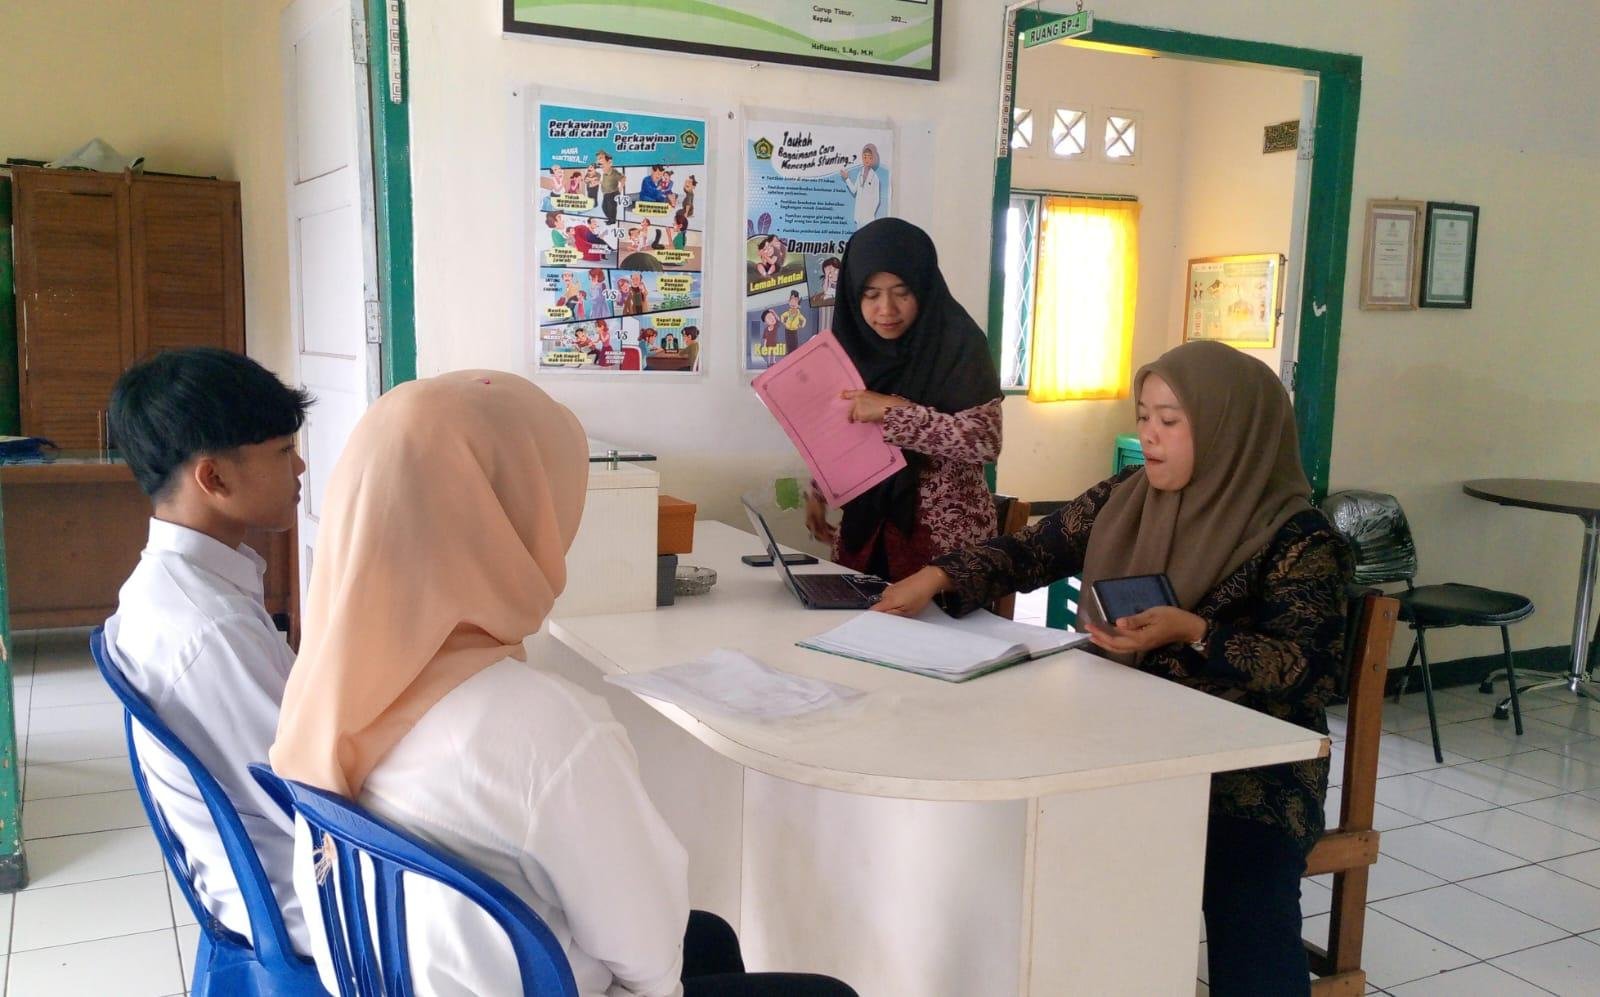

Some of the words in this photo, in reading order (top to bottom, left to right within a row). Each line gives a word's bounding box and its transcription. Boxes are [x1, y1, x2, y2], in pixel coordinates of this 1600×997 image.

[812, 5, 832, 14] Curup
[812, 15, 833, 23] Kepala
[1030, 23, 1059, 42] RUANG
[1061, 16, 1080, 33] BP-4
[549, 120, 613, 129] Perkawinan
[549, 129, 566, 137] tak
[568, 129, 579, 137] di
[580, 129, 608, 137] catat
[614, 133, 676, 143] Perkawinan
[783, 131, 813, 147] Taukah
[616, 142, 627, 151] di
[628, 142, 656, 151] catat
[778, 147, 818, 160] Bagaimana
[819, 145, 835, 155] Cara
[781, 159, 816, 171] Mencegah
[615, 195, 630, 206] VS
[612, 228, 625, 238] VS
[787, 239, 836, 255] Dampak
[750, 277, 777, 292] Lemah
[777, 269, 804, 284] Mental
[604, 289, 617, 299] VS
[616, 331, 628, 340] VS
[754, 343, 787, 357] Kerdil
